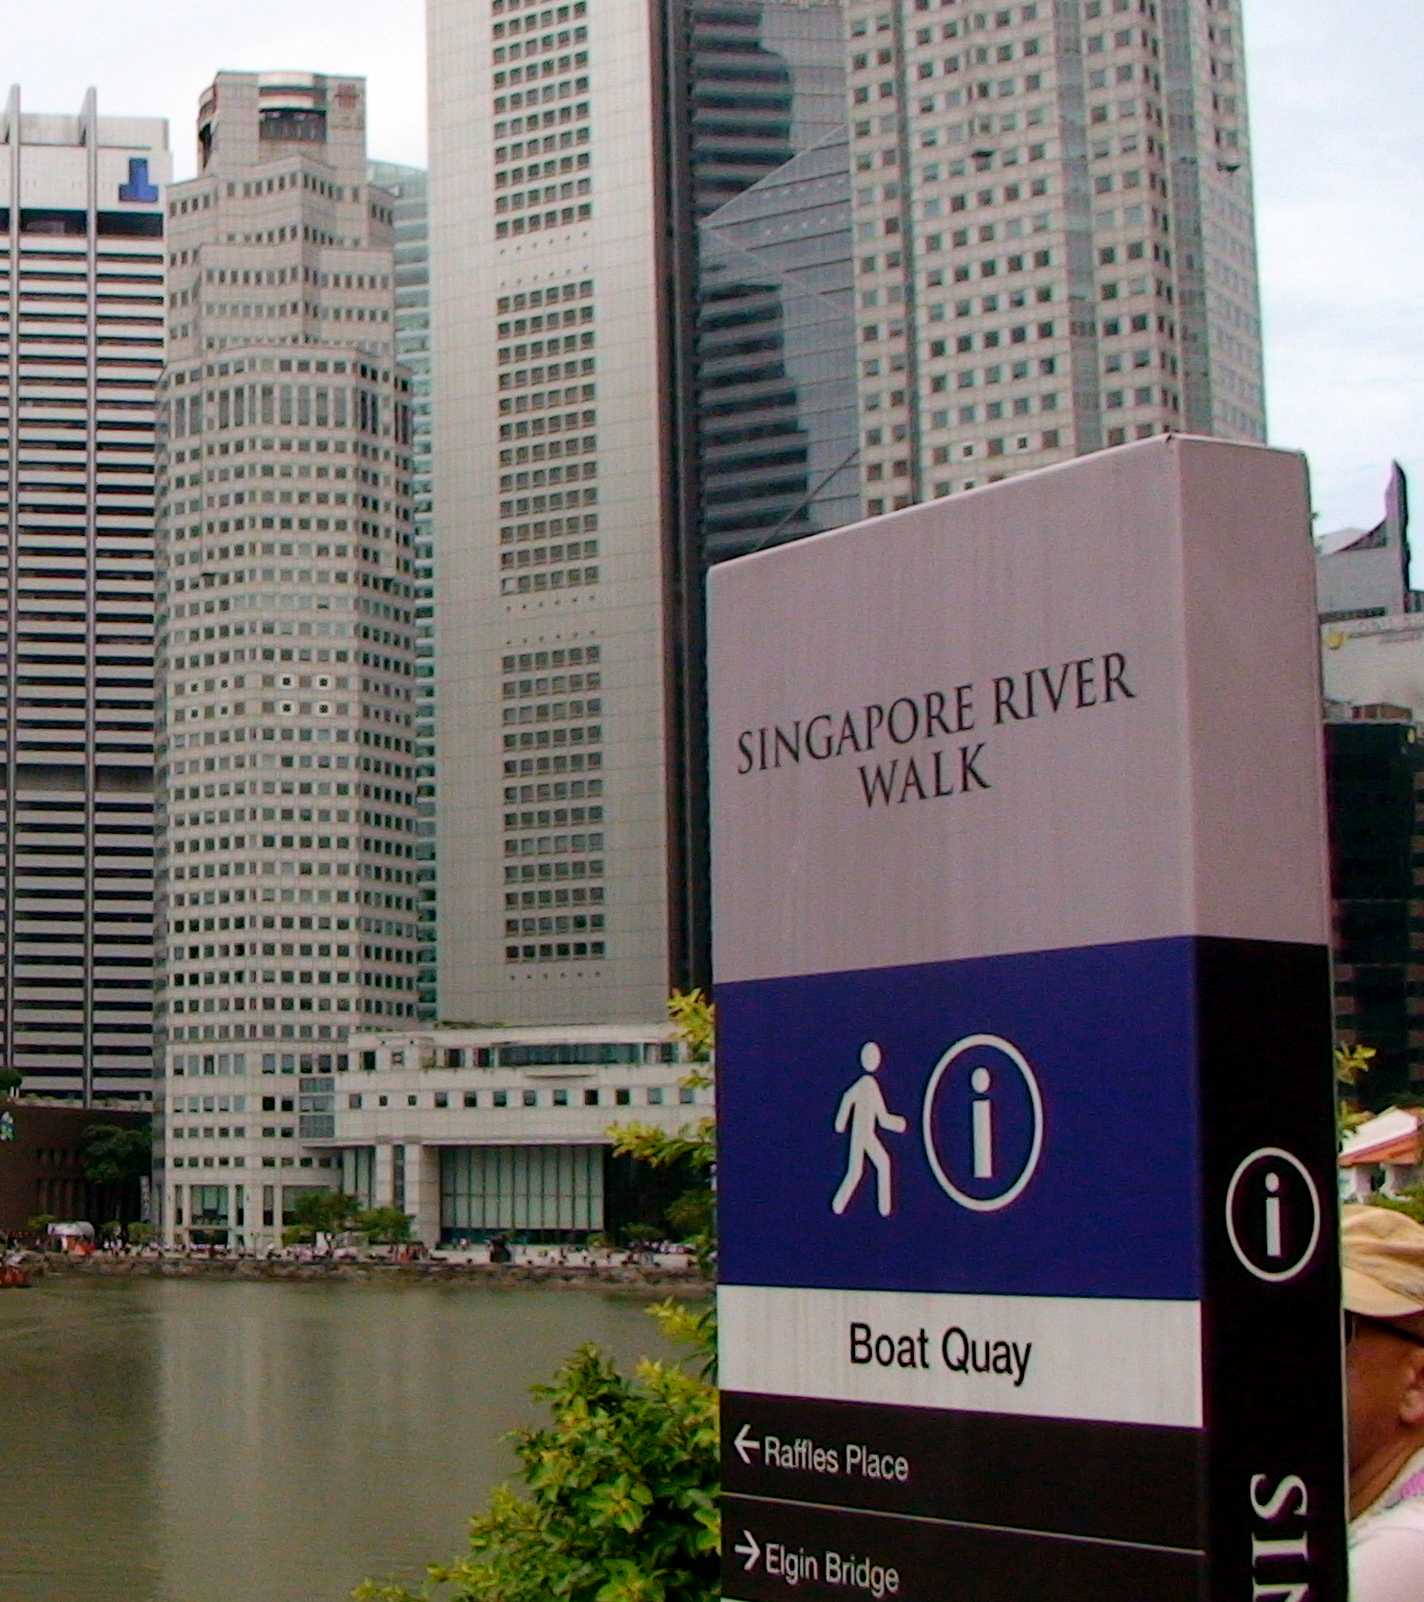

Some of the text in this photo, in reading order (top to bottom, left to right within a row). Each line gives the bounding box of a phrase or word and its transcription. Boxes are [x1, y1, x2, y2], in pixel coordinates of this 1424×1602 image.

[737, 652, 1137, 776] SINGAPORE RIVER
[857, 742, 993, 809] WALK
[849, 1321, 1033, 1388] Boat Quay
[763, 1435, 910, 1482] Raffles Place
[764, 1542, 900, 1599] Elgin Bridge
